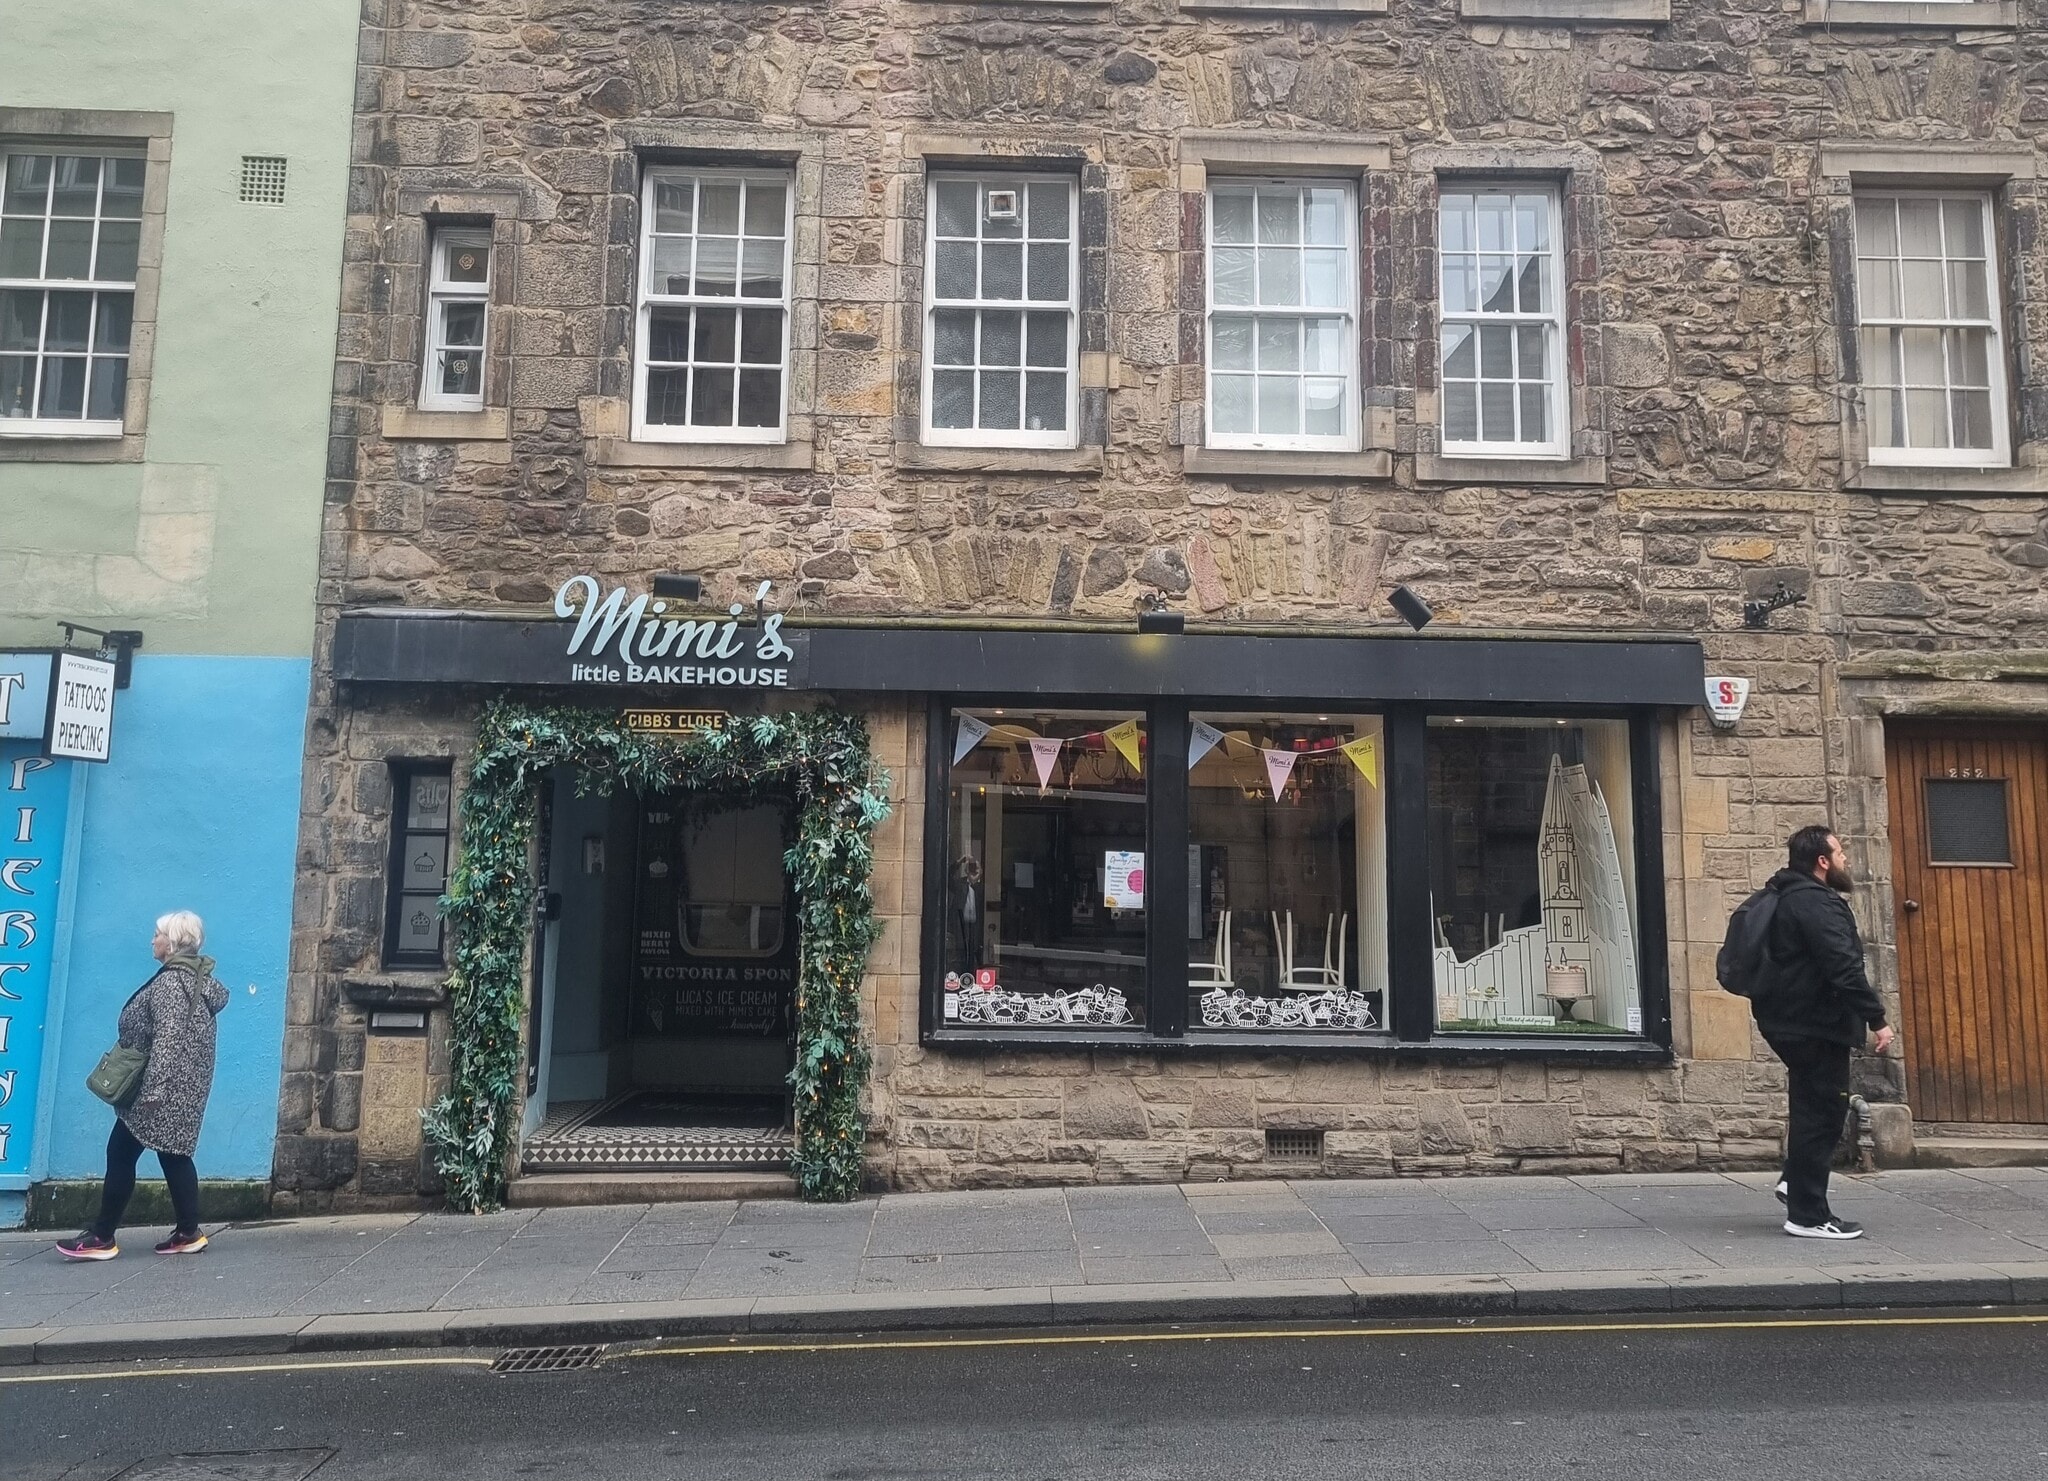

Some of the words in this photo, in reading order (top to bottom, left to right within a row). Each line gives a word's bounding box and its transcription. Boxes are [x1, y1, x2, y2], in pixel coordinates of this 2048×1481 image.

[554, 575, 794, 665] Mimi's
[571, 663, 621, 683] little
[627, 665, 788, 686] BAKEHOUSE
[64, 681, 107, 713] TATTOOS
[628, 713, 671, 727] GIBB'S
[678, 714, 722, 728] CLOSE
[58, 721, 104, 753] PIERCING
[1949, 767, 1984, 778] 252
[640, 966, 738, 980] VICTORIA
[676, 990, 713, 1004] LUCA'S
[718, 990, 735, 1004] ICE
[740, 991, 777, 1005] CREAM
[676, 1006, 701, 1016] MIXED
[704, 1006, 724, 1016] WITH
[757, 1006, 777, 1017] CAKE
